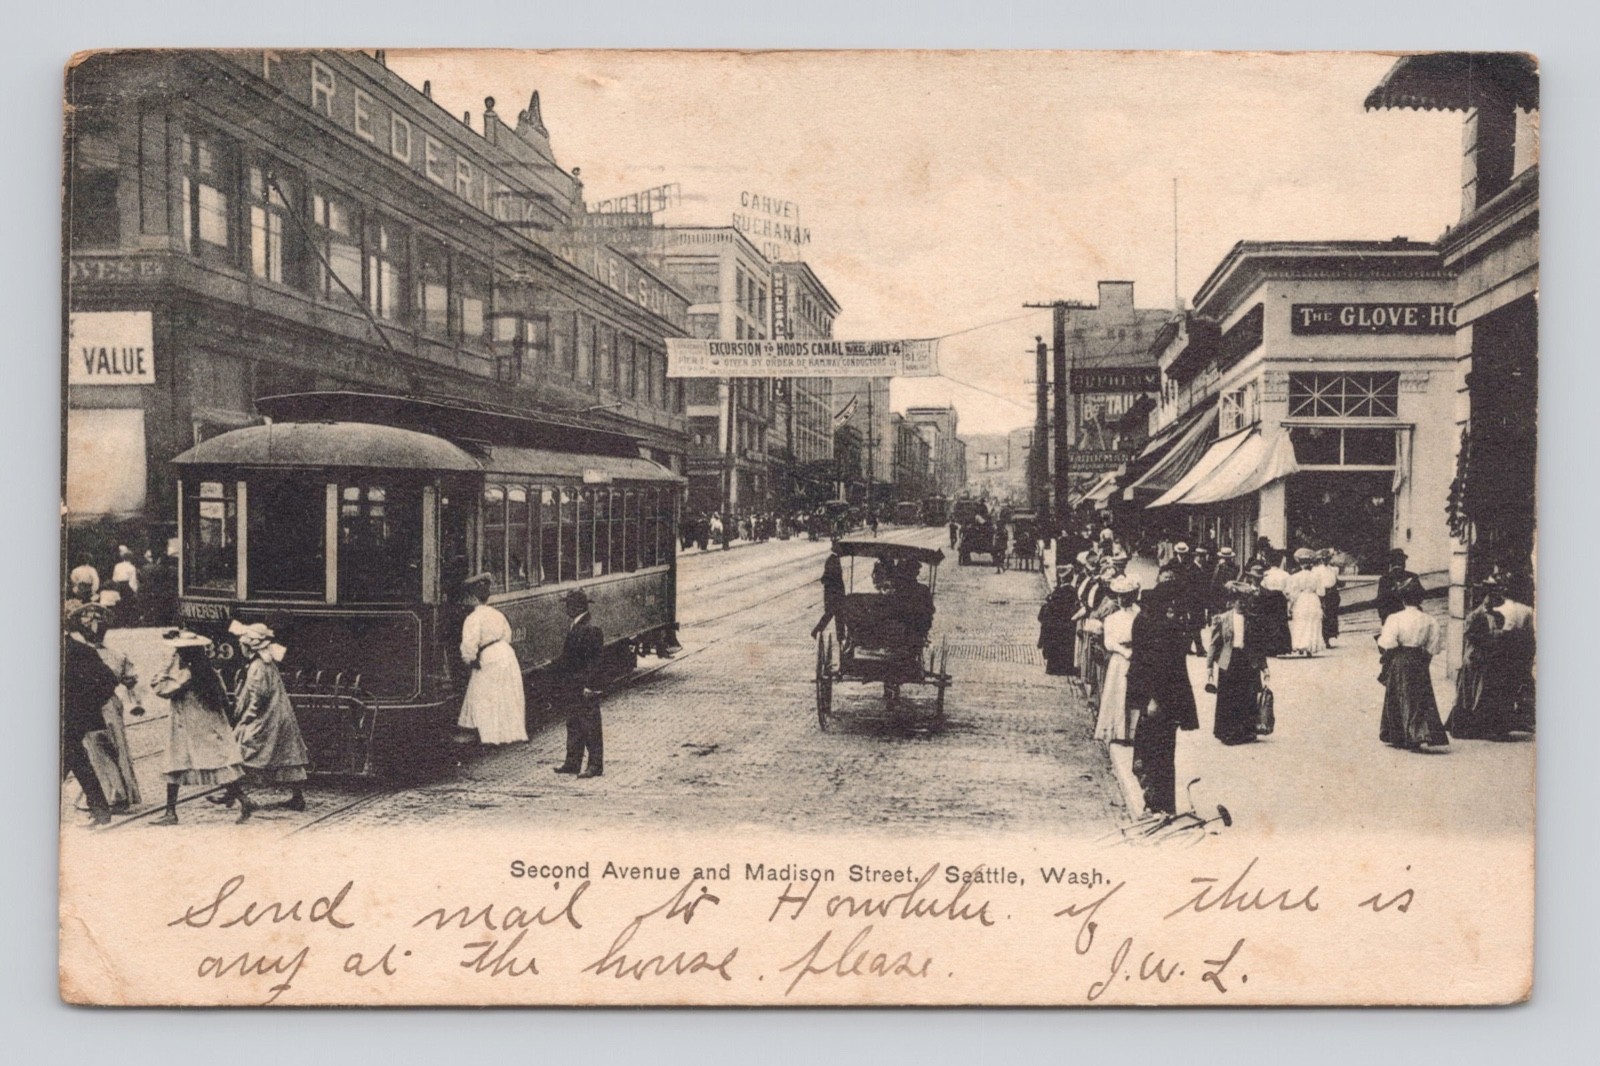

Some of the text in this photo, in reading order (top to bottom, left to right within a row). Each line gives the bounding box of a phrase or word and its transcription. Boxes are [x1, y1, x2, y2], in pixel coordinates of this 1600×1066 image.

[1340, 306, 1418, 327] GLOVE
[709, 341, 762, 356] EXCURSION
[777, 341, 809, 356] HOODS
[811, 341, 844, 356] CANAL
[82, 347, 147, 375] VALUE
[724, 358, 750, 367] GIVEN
[766, 357, 794, 367] ORDER
[179, 602, 231, 620] UNIVERSITY
[167, 874, 356, 929] Send
[412, 880, 591, 930] mail
[635, 876, 721, 924] to
[1054, 879, 1127, 955] if
[1162, 856, 1320, 920] there
[1357, 864, 1415, 913] is
[196, 945, 311, 1006] any
[460, 928, 540, 977] the
